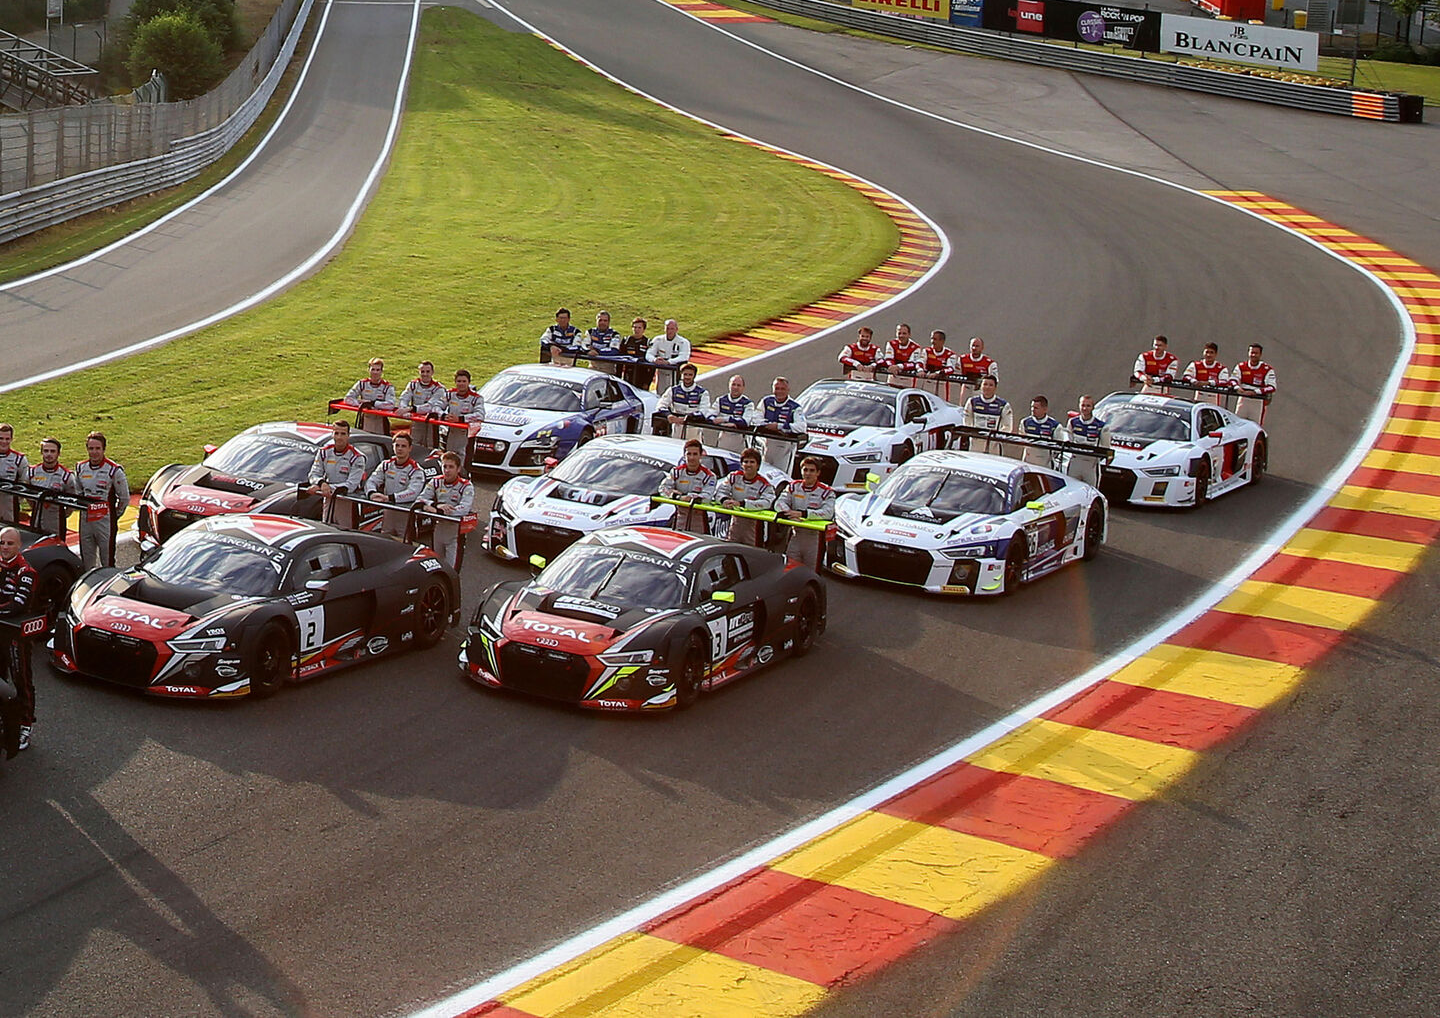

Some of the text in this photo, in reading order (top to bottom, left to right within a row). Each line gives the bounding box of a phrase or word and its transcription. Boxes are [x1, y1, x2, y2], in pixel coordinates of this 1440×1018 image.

[1020, 11, 1044, 21] une
[1100, 11, 1121, 20] ROCK
[1129, 15, 1145, 24] POP
[1081, 26, 1091, 35] 21
[1174, 32, 1304, 64] BLANCPAIN
[601, 449, 666, 468] BLANCPAIN
[931, 466, 999, 486] BLANCPAIN
[90, 503, 108, 511] TOTAL
[177, 491, 233, 510] TOTAL
[203, 533, 285, 562] BLANCPAIN 2
[601, 548, 688, 574] BLANCPAIN 3
[101, 603, 163, 630] TOTAL
[306, 621, 316, 648] 2
[521, 619, 592, 645] TOTAL
[713, 632, 722, 659] 3
[165, 685, 197, 693] TOTAL
[597, 699, 628, 709] TOTAL
